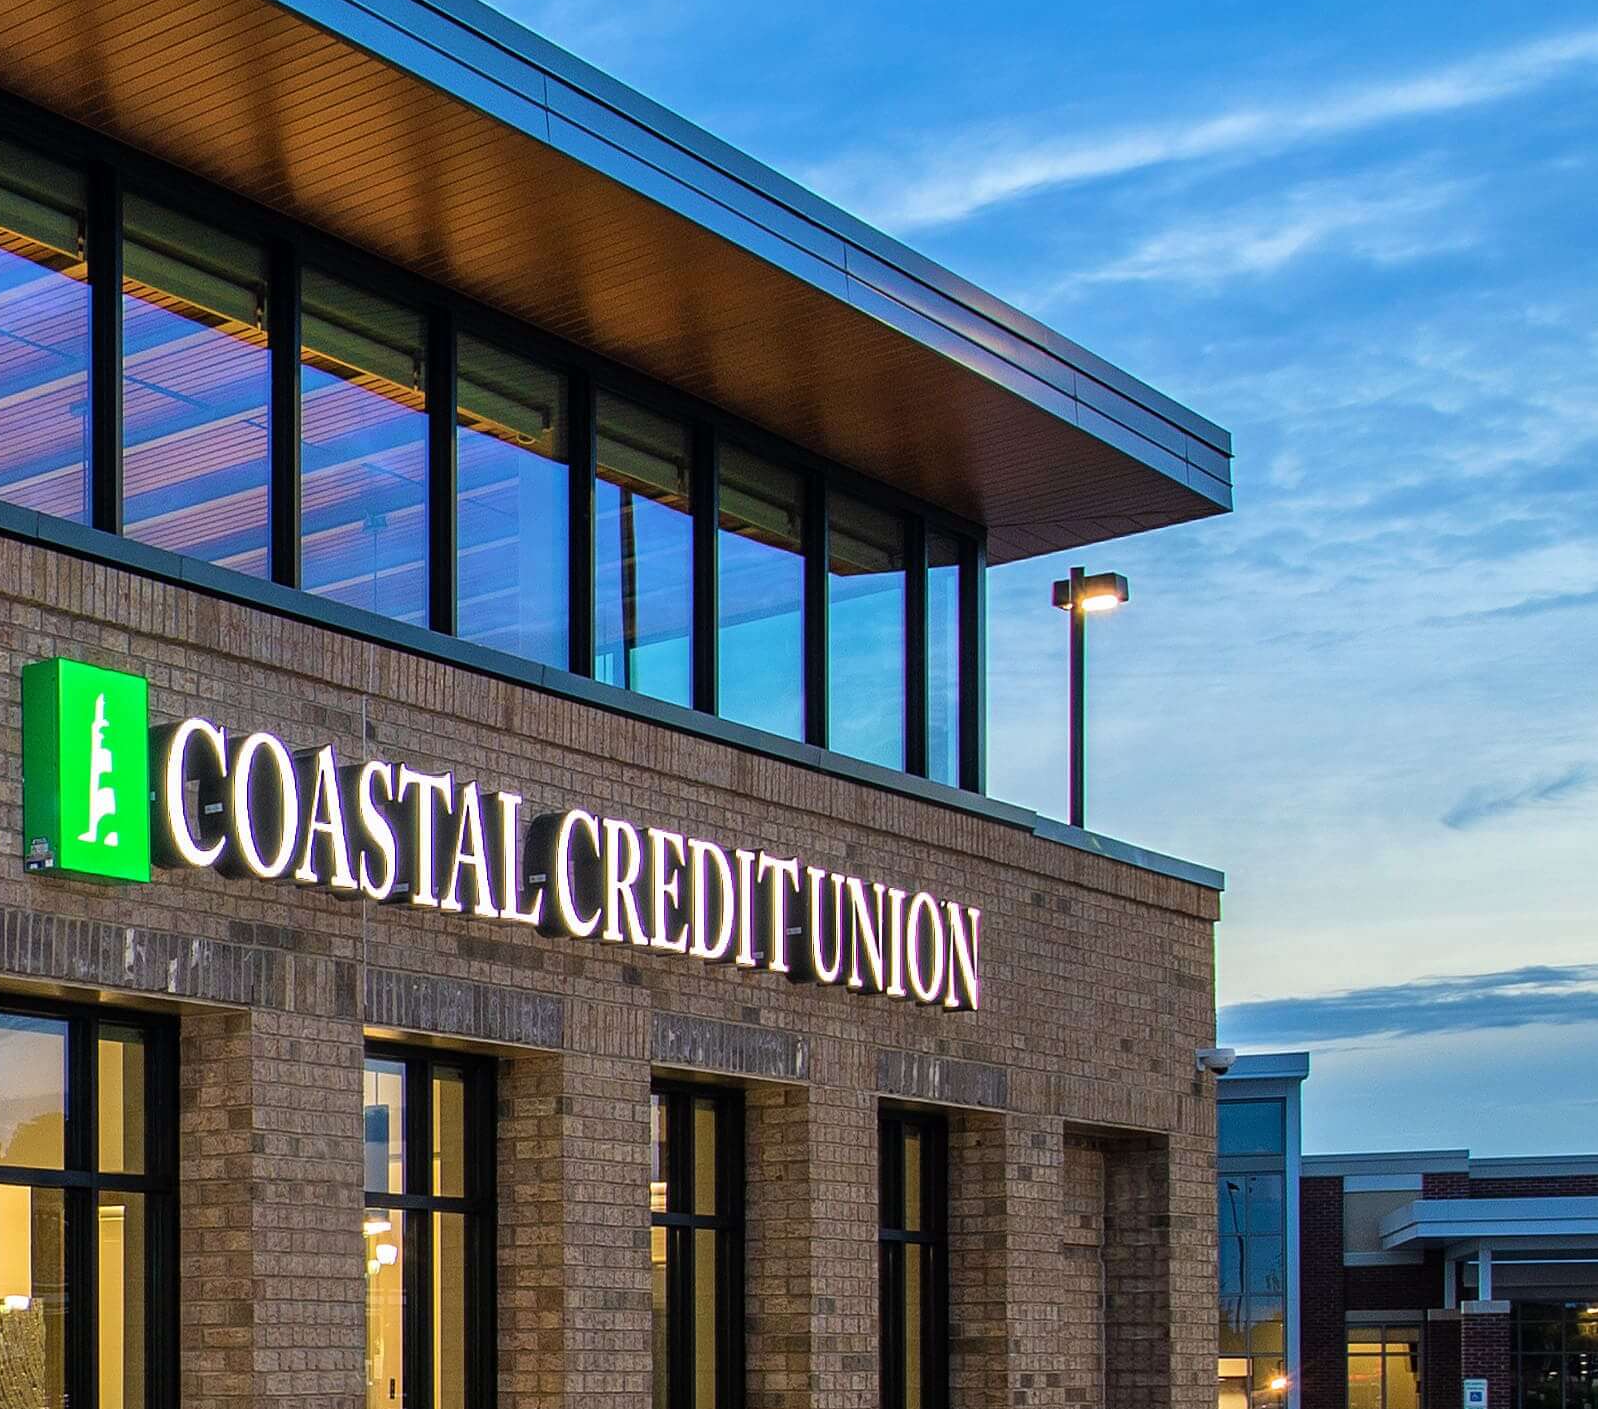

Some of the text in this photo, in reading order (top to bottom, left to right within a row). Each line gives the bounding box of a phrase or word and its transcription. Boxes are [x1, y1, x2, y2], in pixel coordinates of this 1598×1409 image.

[165, 717, 981, 1011] COASTAL CREDIT UNION
